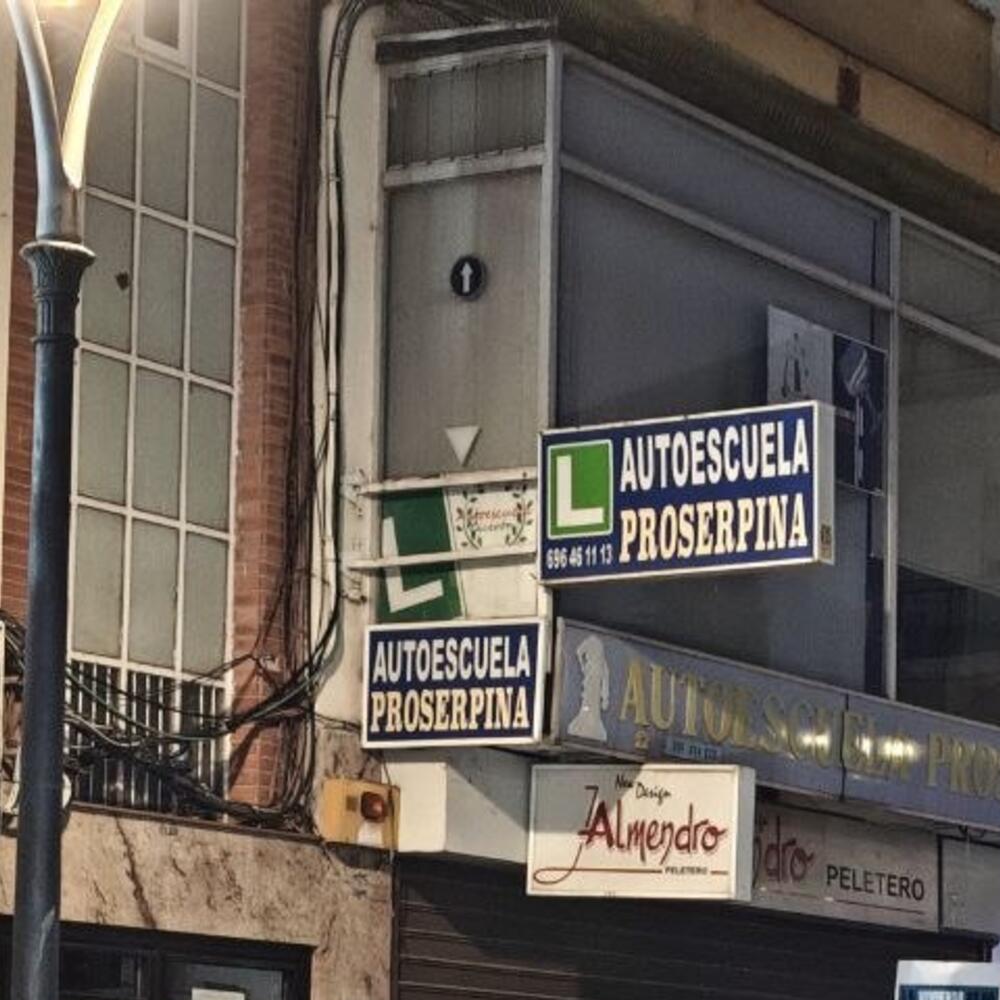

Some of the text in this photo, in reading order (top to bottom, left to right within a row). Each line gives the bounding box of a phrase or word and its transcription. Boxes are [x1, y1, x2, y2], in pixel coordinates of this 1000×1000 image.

[620, 418, 809, 493] AUTOESCUELA
[556, 455, 605, 527] L
[619, 493, 808, 564] PROSERPINA
[585, 544, 597, 566] 11
[372, 634, 531, 684] AUTOESCUELA
[369, 686, 529, 733] PROSERPINA
[826, 864, 925, 901] PELETERO
